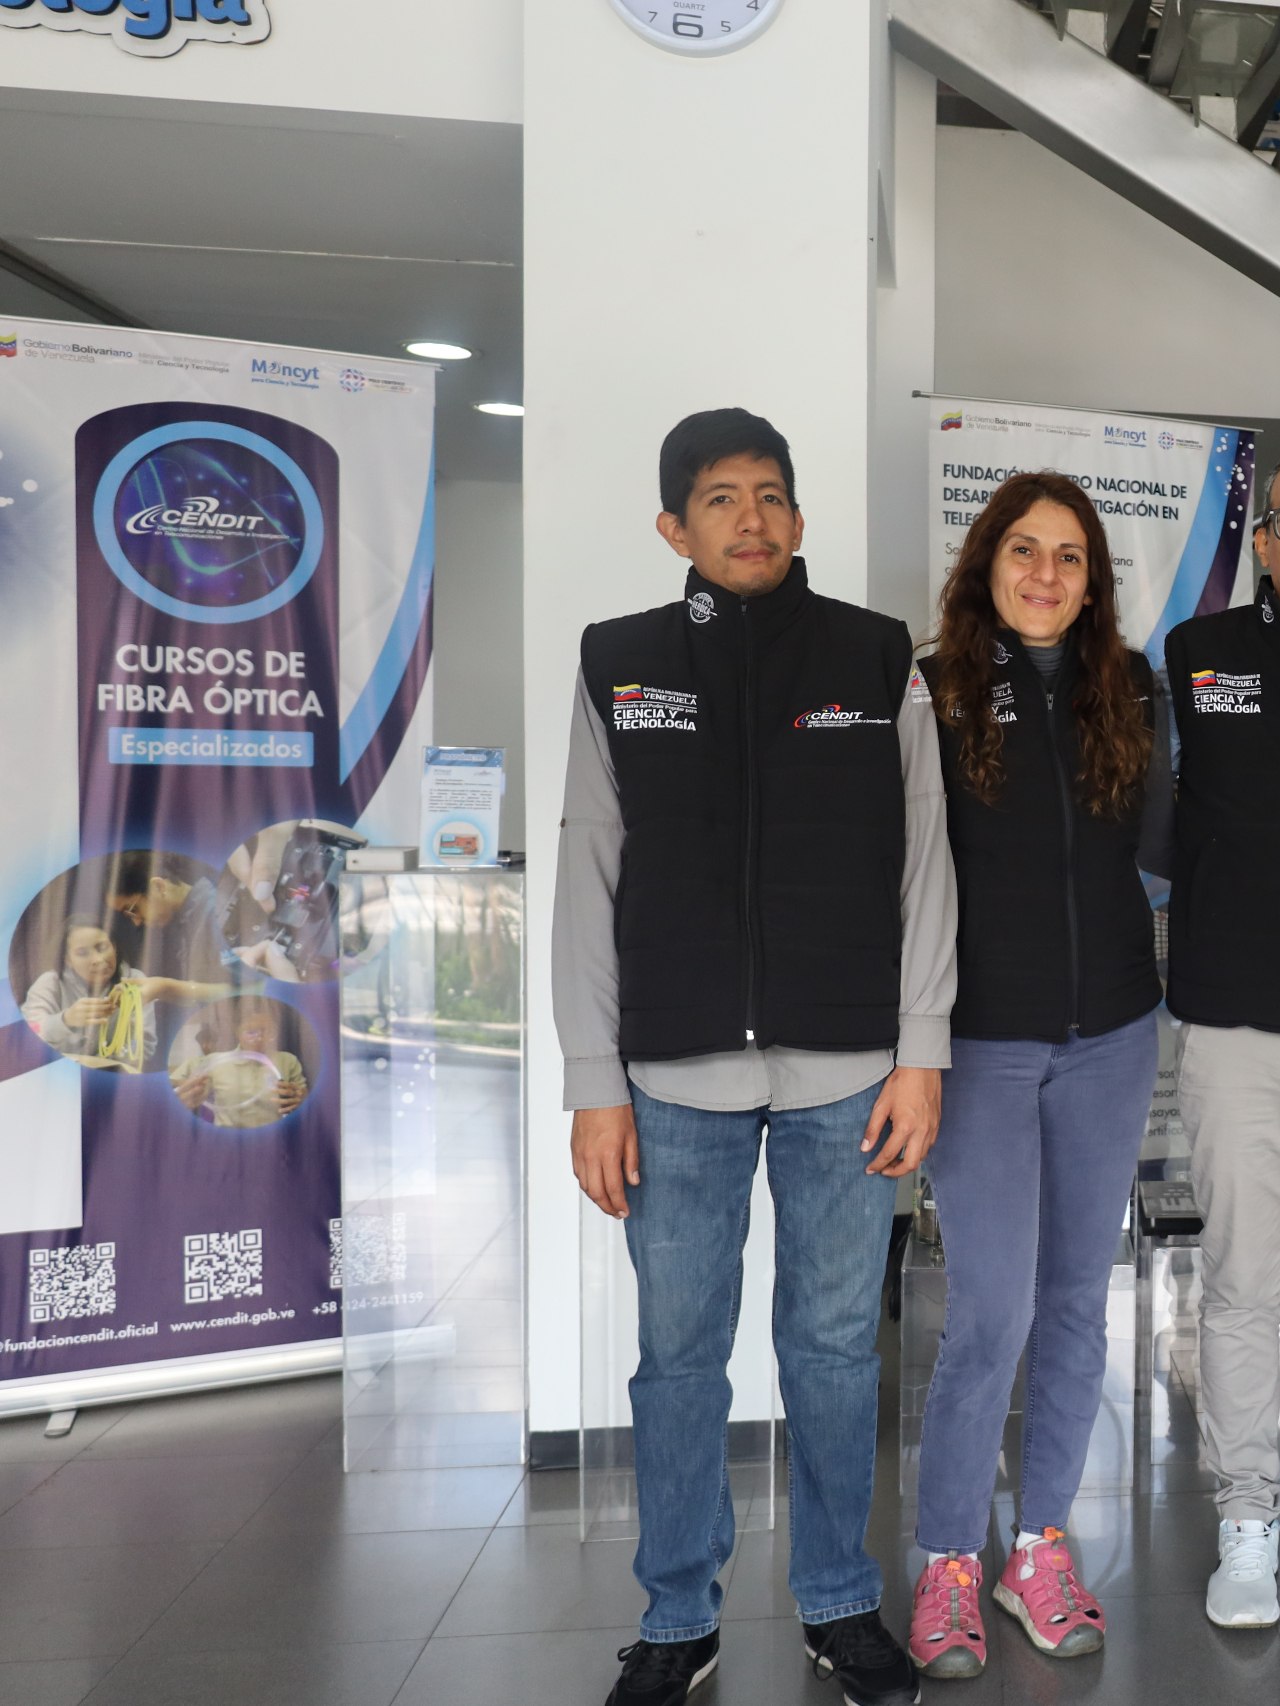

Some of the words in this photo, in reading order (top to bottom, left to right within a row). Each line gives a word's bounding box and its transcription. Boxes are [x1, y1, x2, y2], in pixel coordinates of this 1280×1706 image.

[673, 1, 706, 11] QUARTZ
[648, 11, 658, 23] 7
[673, 12, 704, 38] 6
[720, 21, 731, 32] 5
[1097, 477, 1168, 498] NACIONAL
[1171, 485, 1188, 499] DE
[161, 509, 265, 530] CENDIT
[1162, 506, 1179, 521] EN
[116, 644, 255, 677] CURSOS
[265, 650, 306, 678] DE
[1216, 678, 1261, 687] VENEZUELA
[97, 683, 194, 713] FIBRA
[203, 680, 324, 717] ÓPTICA
[643, 692, 697, 705] VENEZUELA
[1194, 694, 1235, 704] CIENCIA
[1237, 695, 1245, 704] Y
[614, 708, 666, 720] CIENCIA
[669, 709, 678, 719] Y
[1194, 702, 1261, 713] TECNOLOGÍA
[811, 711, 863, 720] CENDIT
[614, 718, 697, 731] TECNOLOGÍA
[121, 733, 303, 761] Especializados
[170, 1306, 296, 1333] www.cendit.gob.ve
[312, 1300, 338, 1315] +58
